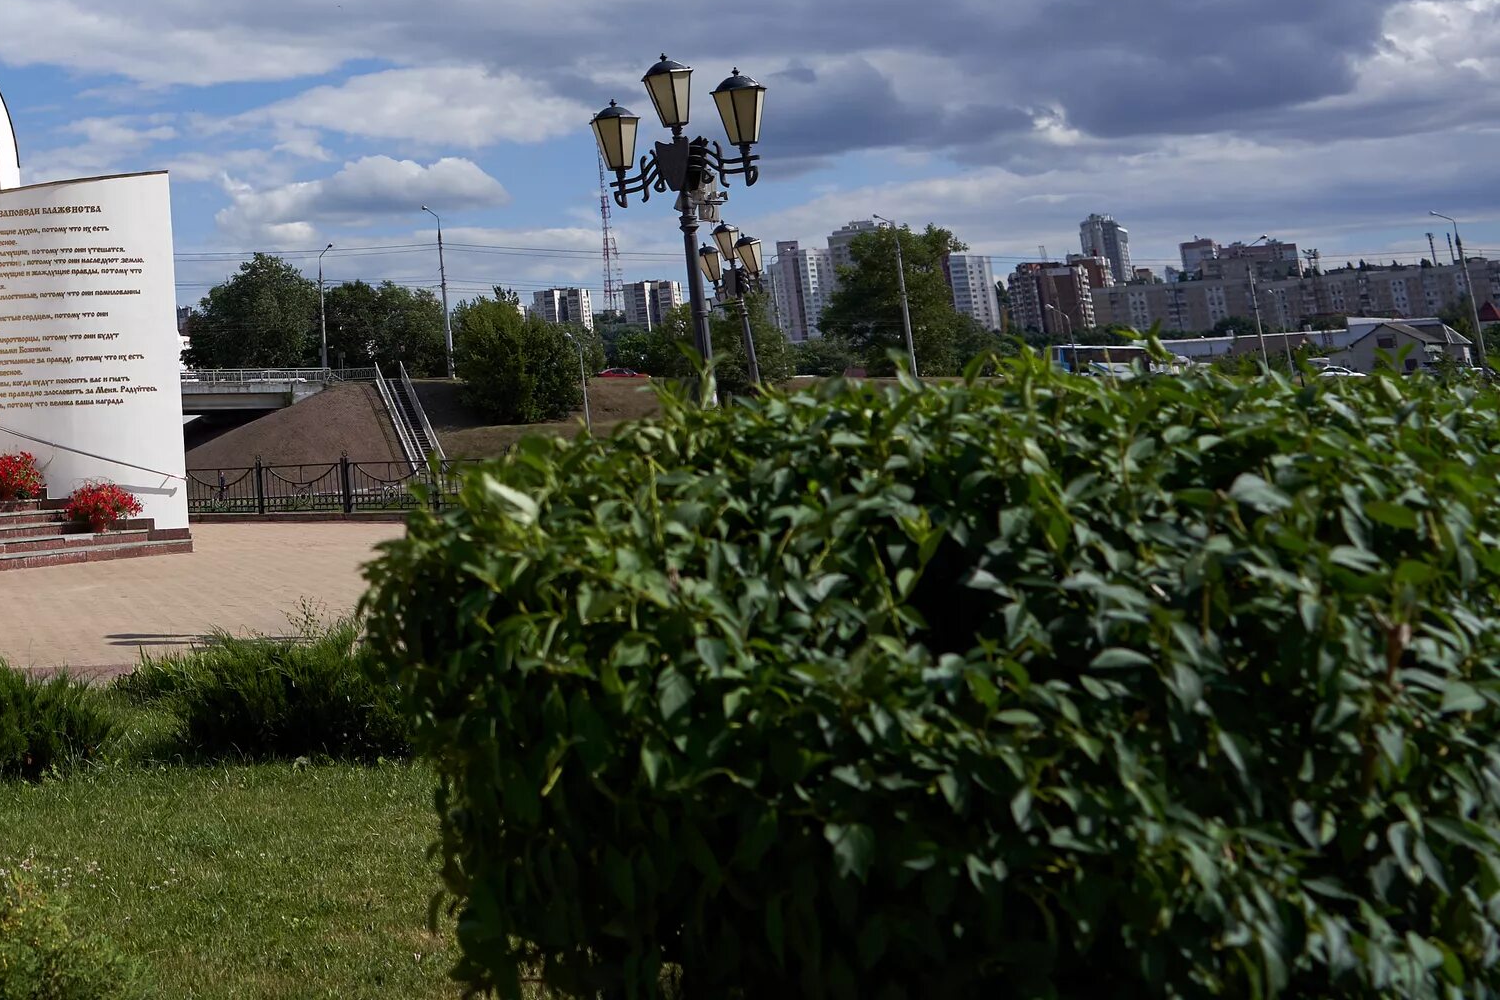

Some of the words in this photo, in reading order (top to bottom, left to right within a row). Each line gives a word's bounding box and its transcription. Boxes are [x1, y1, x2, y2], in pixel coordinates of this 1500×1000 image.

[32, 269, 70, 277] жаждущие
[8, 391, 42, 399] праведно
[120, 386, 157, 394] Радуйтесь
